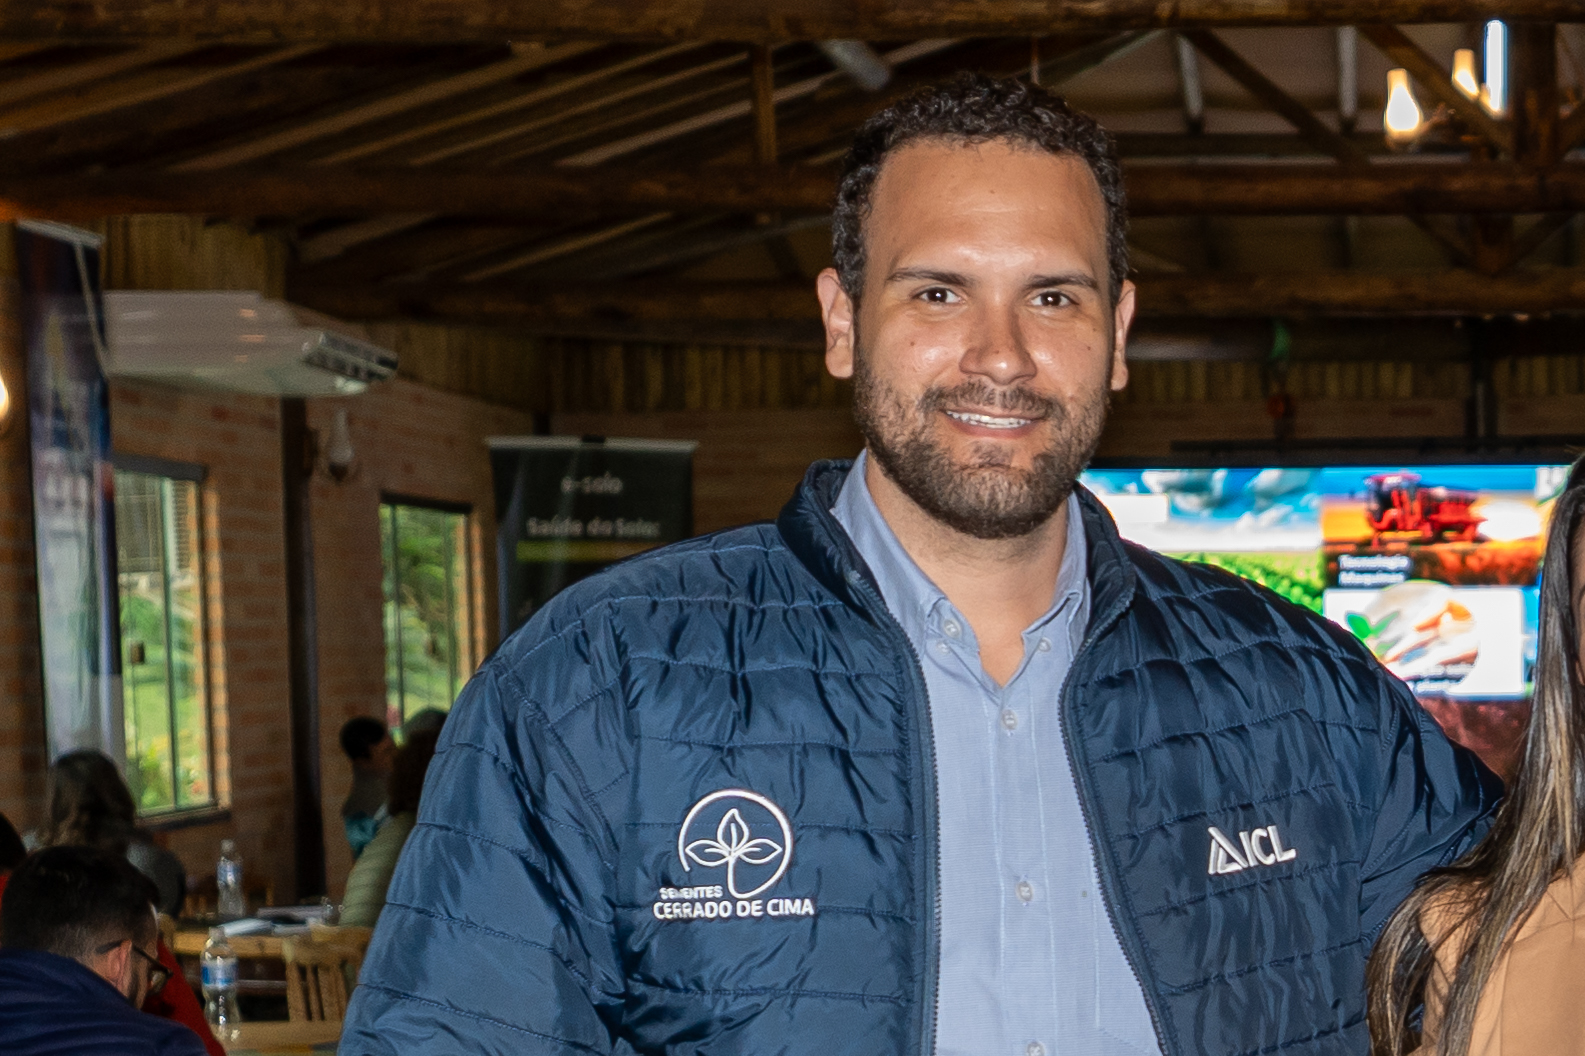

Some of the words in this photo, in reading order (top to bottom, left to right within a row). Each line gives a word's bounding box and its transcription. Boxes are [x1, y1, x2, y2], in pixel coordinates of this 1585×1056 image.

[653, 901, 732, 919] CERRADO
[736, 899, 763, 917] DE
[766, 898, 815, 916] CIMA
